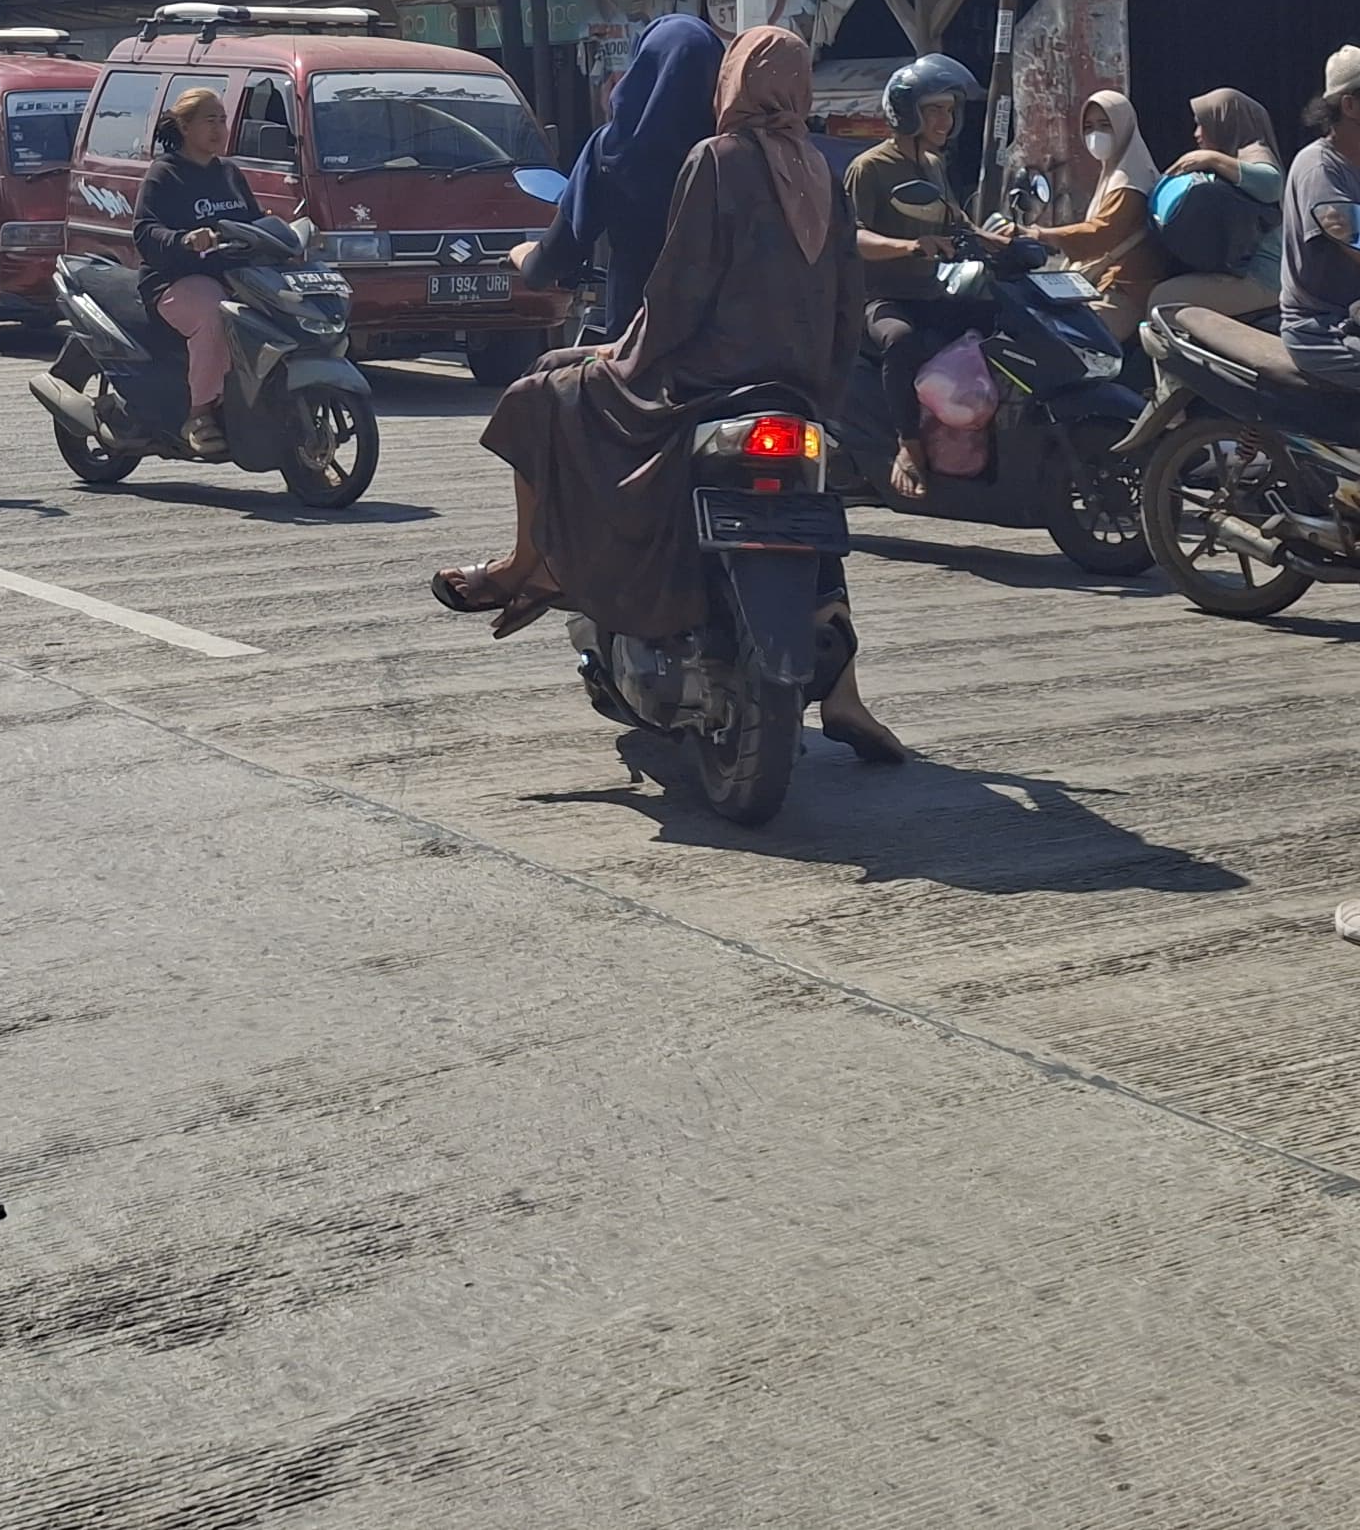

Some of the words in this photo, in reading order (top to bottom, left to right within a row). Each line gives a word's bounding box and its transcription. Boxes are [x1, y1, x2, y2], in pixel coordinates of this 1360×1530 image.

[431, 277, 440, 294] B
[451, 276, 478, 293] 1994
[486, 275, 510, 291] URH
